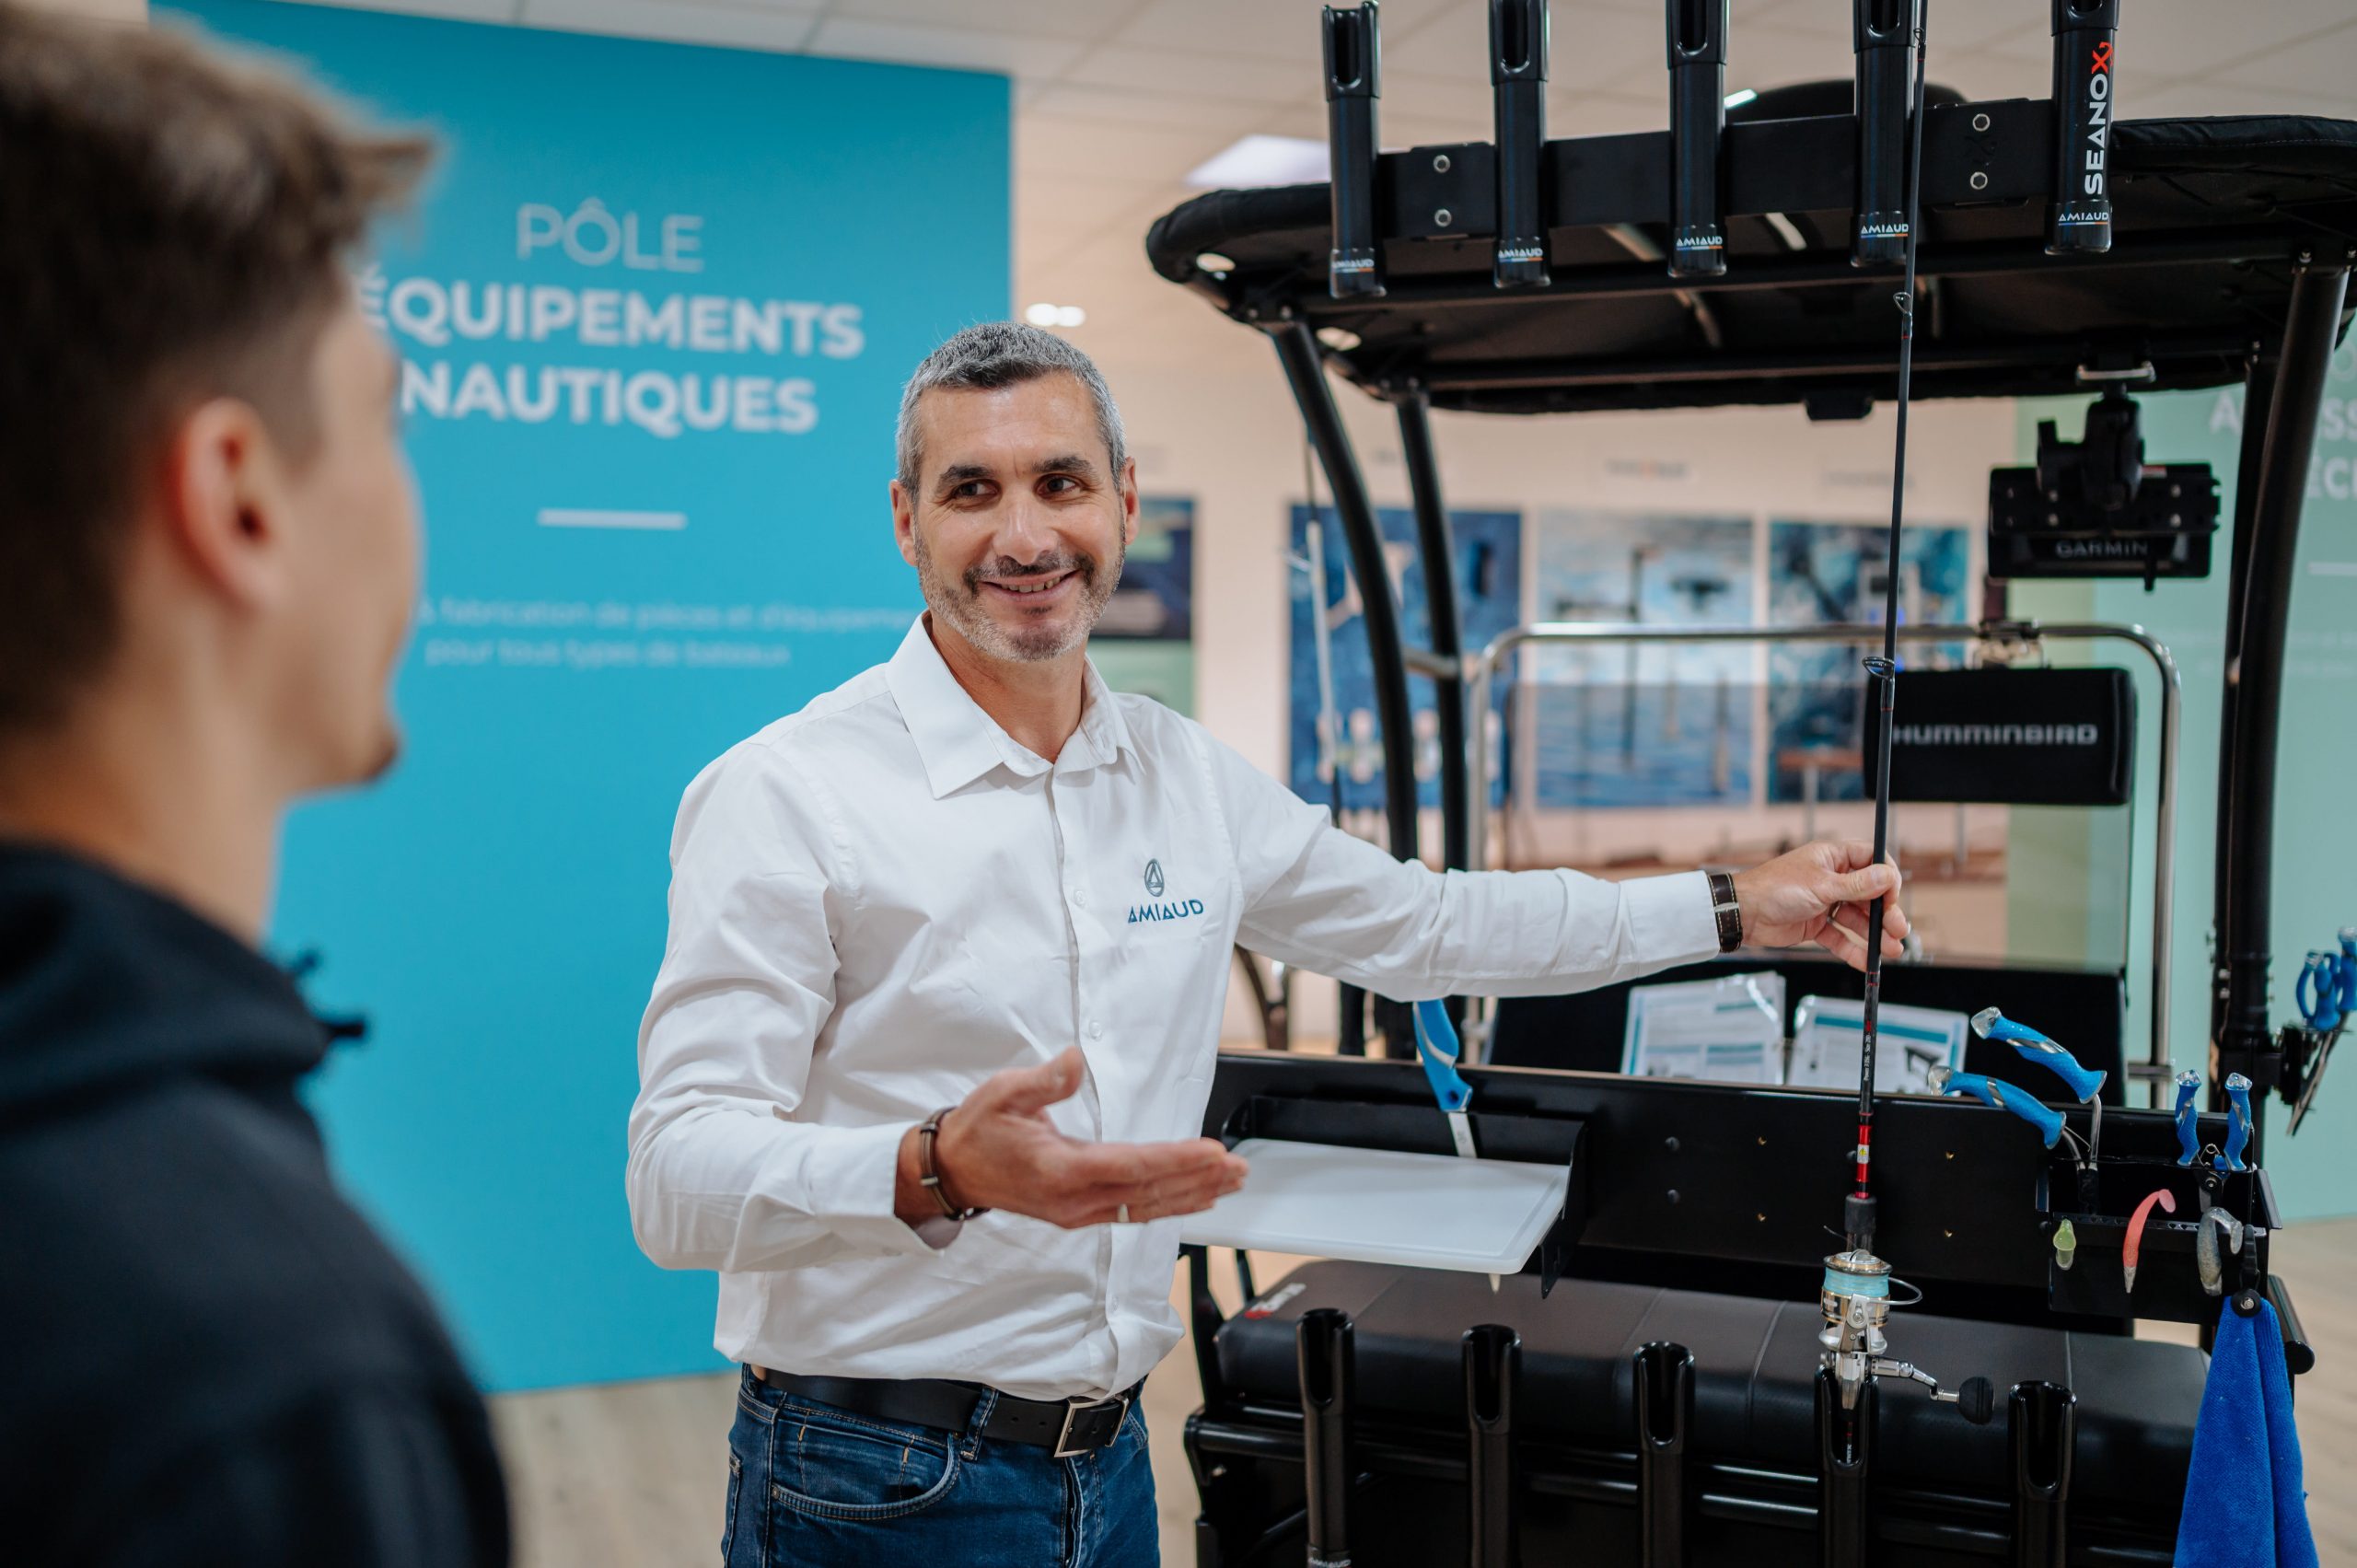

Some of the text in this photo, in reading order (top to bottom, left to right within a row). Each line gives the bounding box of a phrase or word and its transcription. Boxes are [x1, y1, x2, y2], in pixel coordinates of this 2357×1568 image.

[2084, 41, 2113, 195] SEANOX
[2058, 212, 2108, 221] AMIAUD
[518, 199, 705, 273] PÔLE
[1860, 223, 1909, 234] AMIAUD
[1676, 236, 1723, 247] AMIAUD
[1498, 248, 1543, 259] AMIAUD
[355, 263, 865, 360] ÉQUIPEMENTS
[400, 358, 818, 438] NAUTIQUES
[2055, 540, 2148, 558] GARMIN
[1128, 899, 1204, 923] AMIAUD
